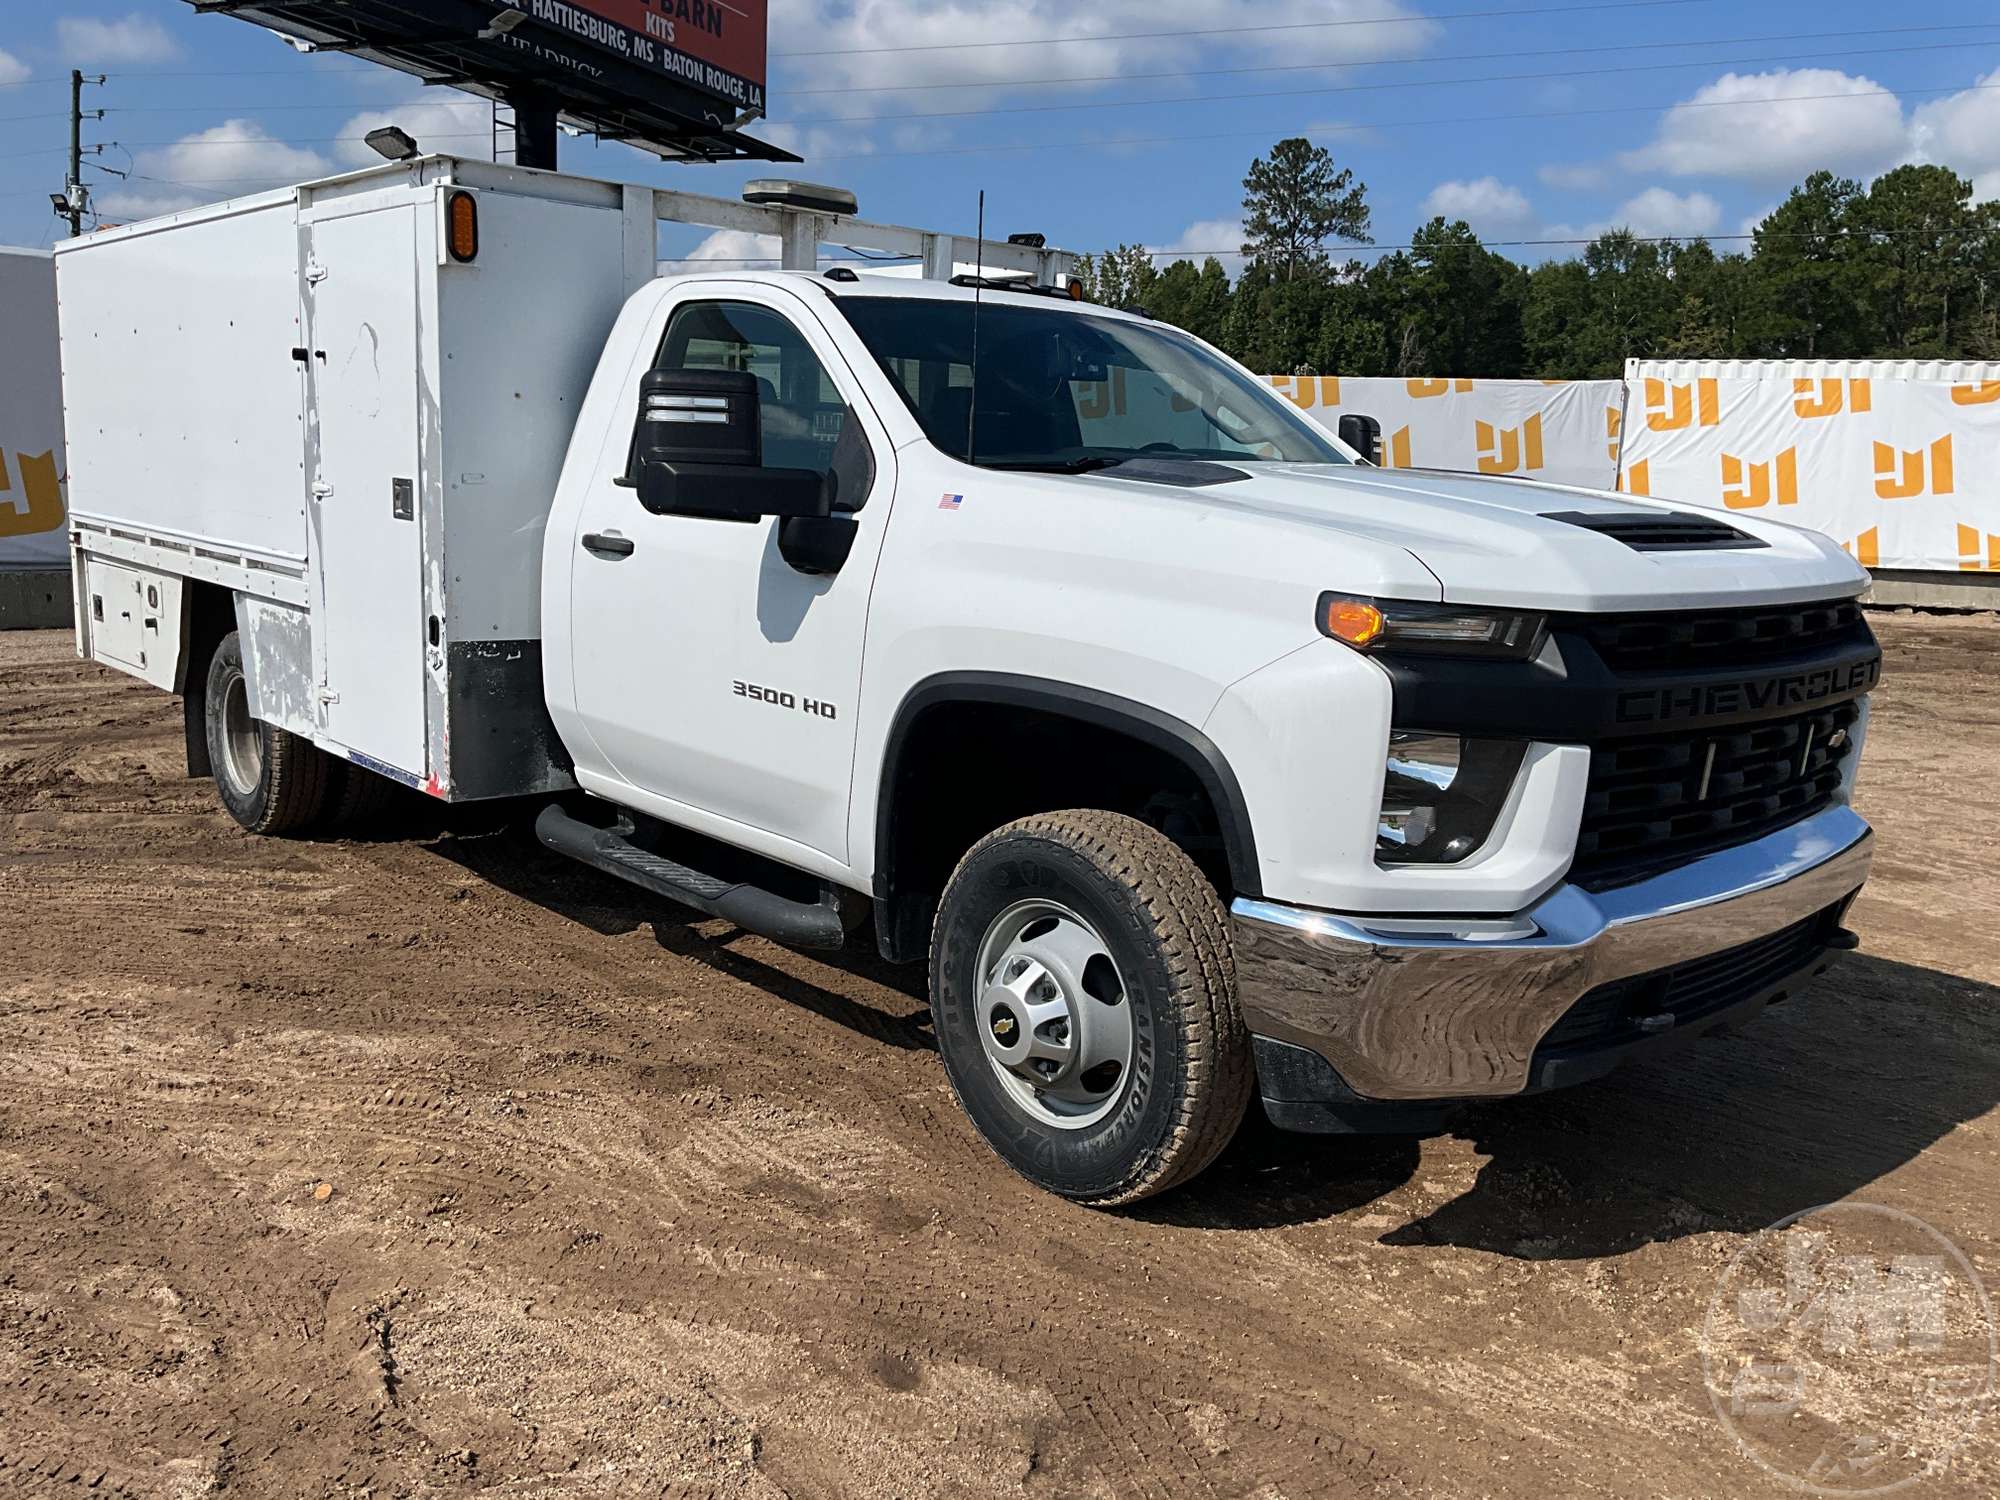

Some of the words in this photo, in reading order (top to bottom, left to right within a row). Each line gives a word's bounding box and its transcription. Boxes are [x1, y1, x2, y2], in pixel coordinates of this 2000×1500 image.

[532, 0, 631, 57] HATTIESBURG,
[633, 36, 655, 63] MS
[663, 48, 704, 84] BATON
[706, 66, 747, 104] ROUGE,
[749, 84, 762, 107] LA
[645, 11, 675, 43] KITS
[732, 679, 796, 710] 3500
[803, 696, 837, 720] HD
[1615, 656, 1880, 724] CHEVROLET
